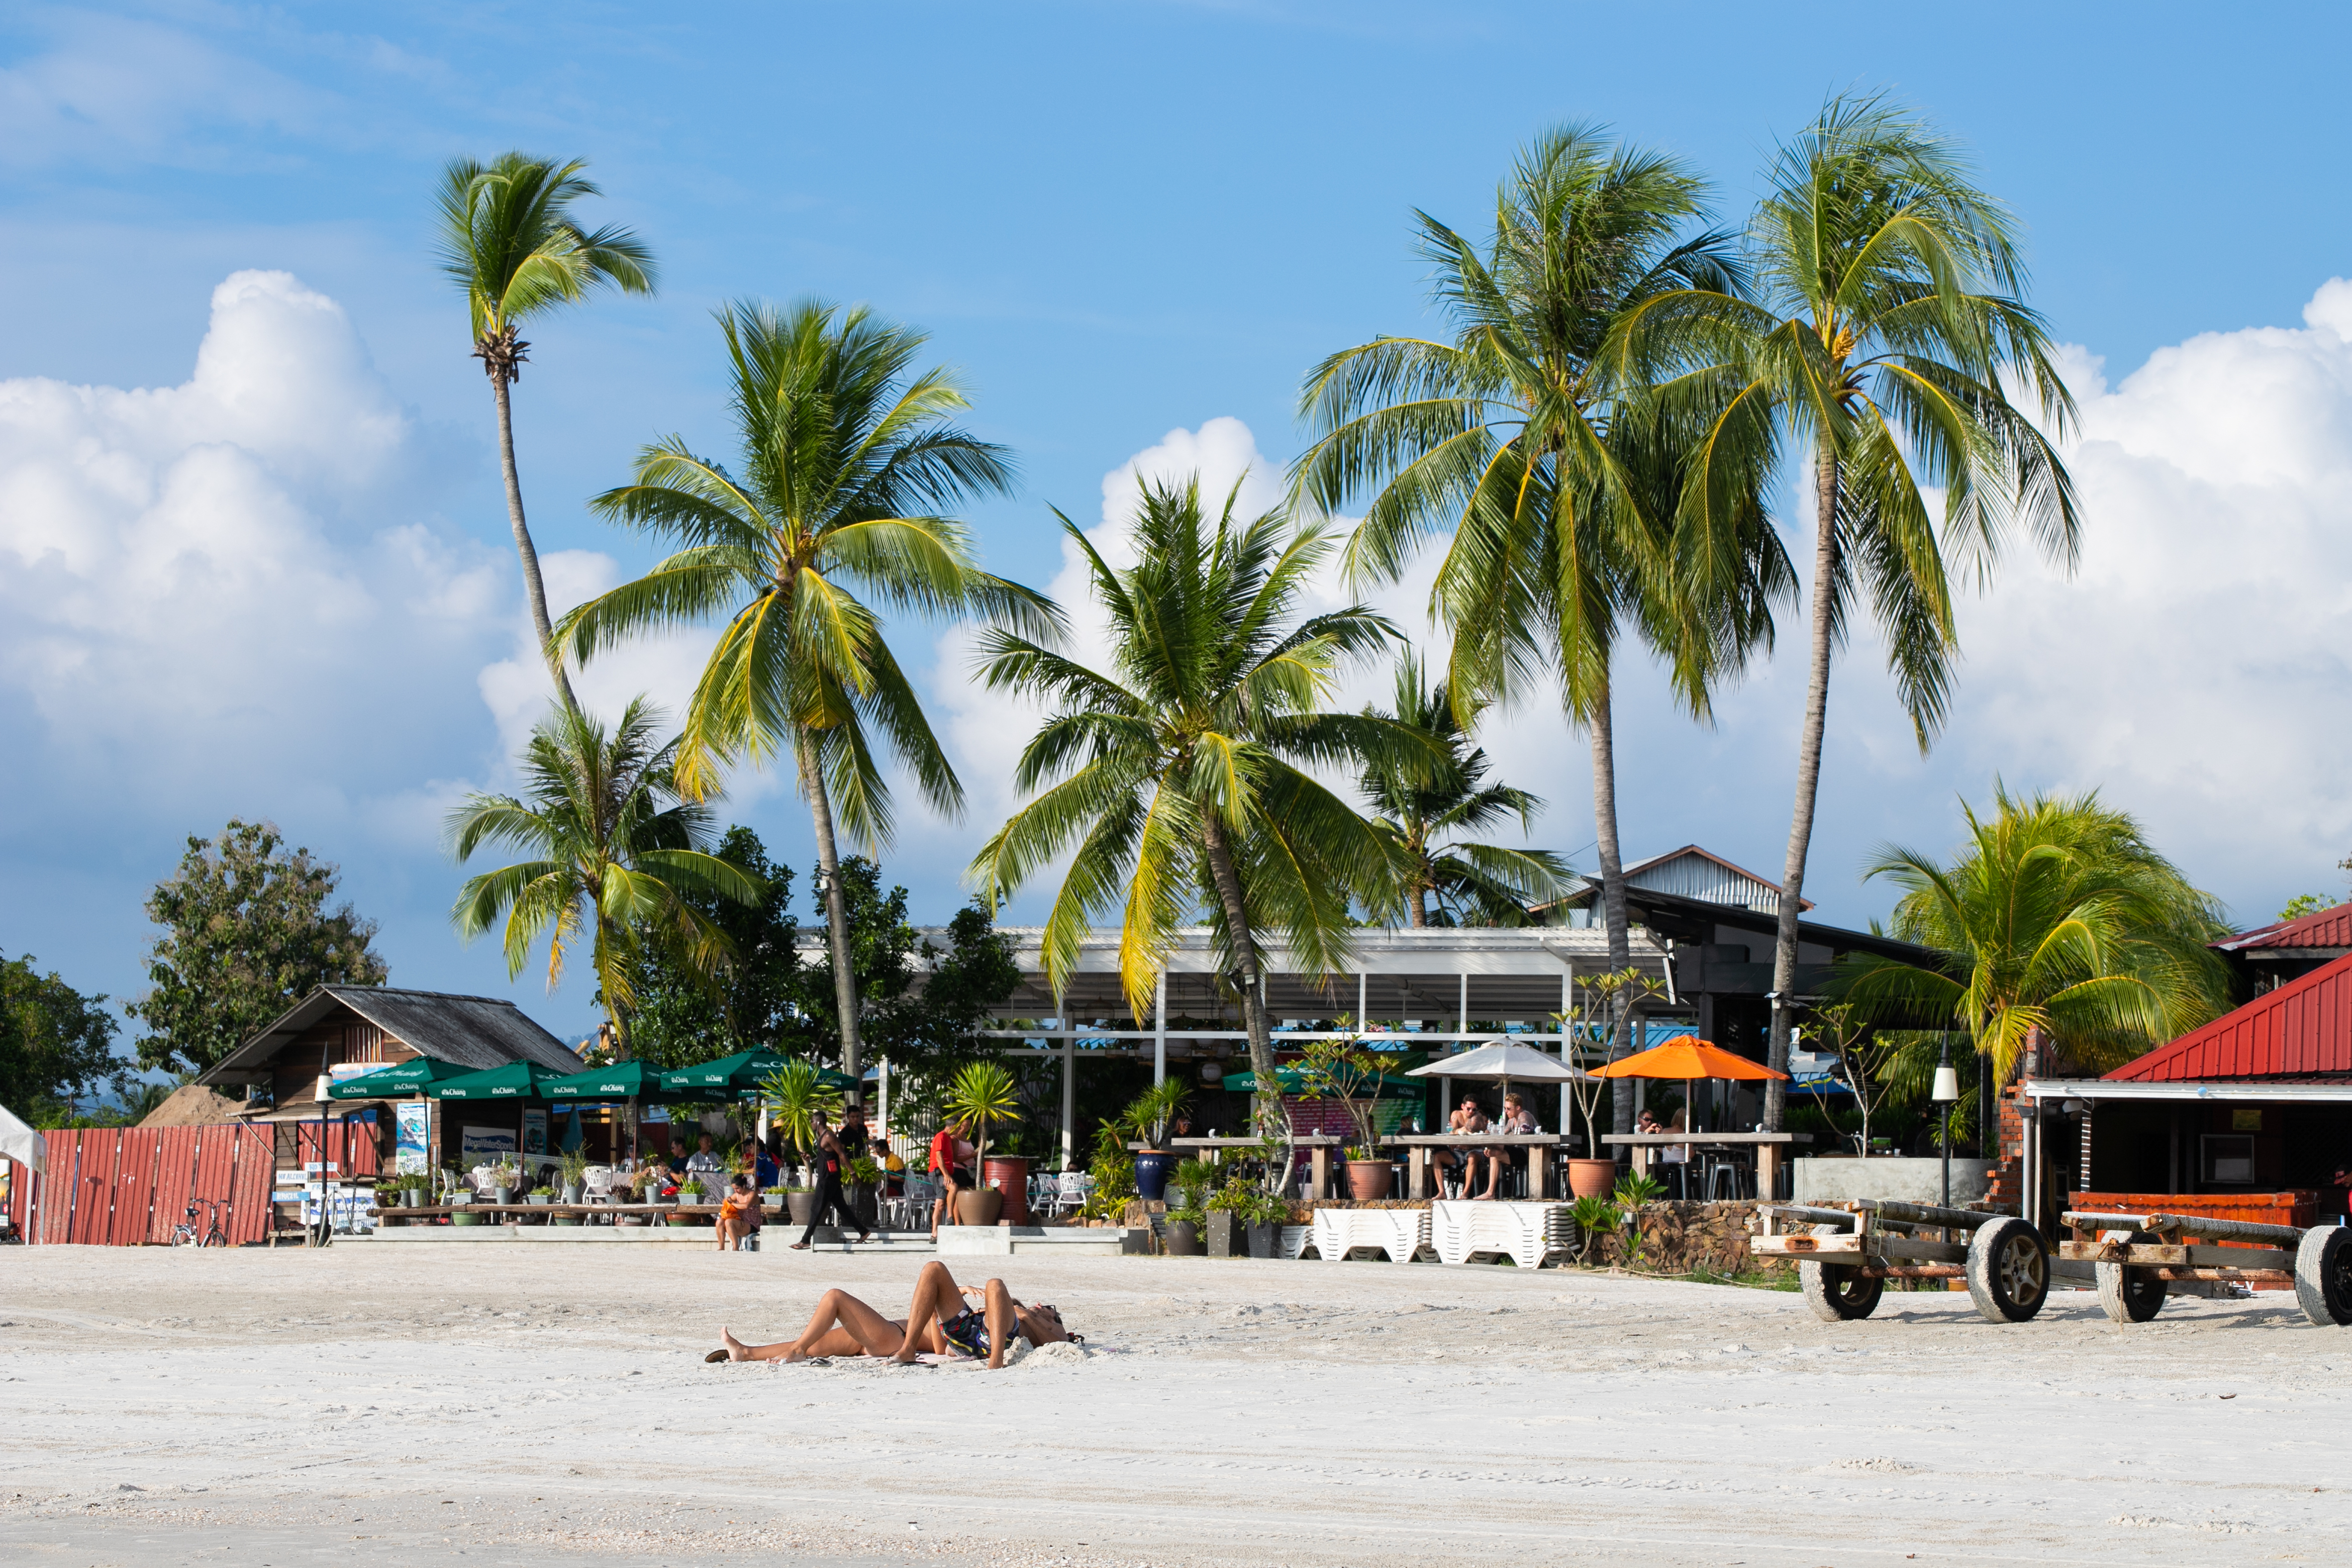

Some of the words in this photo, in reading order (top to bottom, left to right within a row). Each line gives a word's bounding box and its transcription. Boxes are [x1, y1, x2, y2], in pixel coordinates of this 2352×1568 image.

[608, 1085, 625, 1093] Chang
[1403, 1088, 1415, 1097] Chang
[712, 1090, 726, 1098] Chang
[464, 1137, 514, 1151] MegaWaterSports
